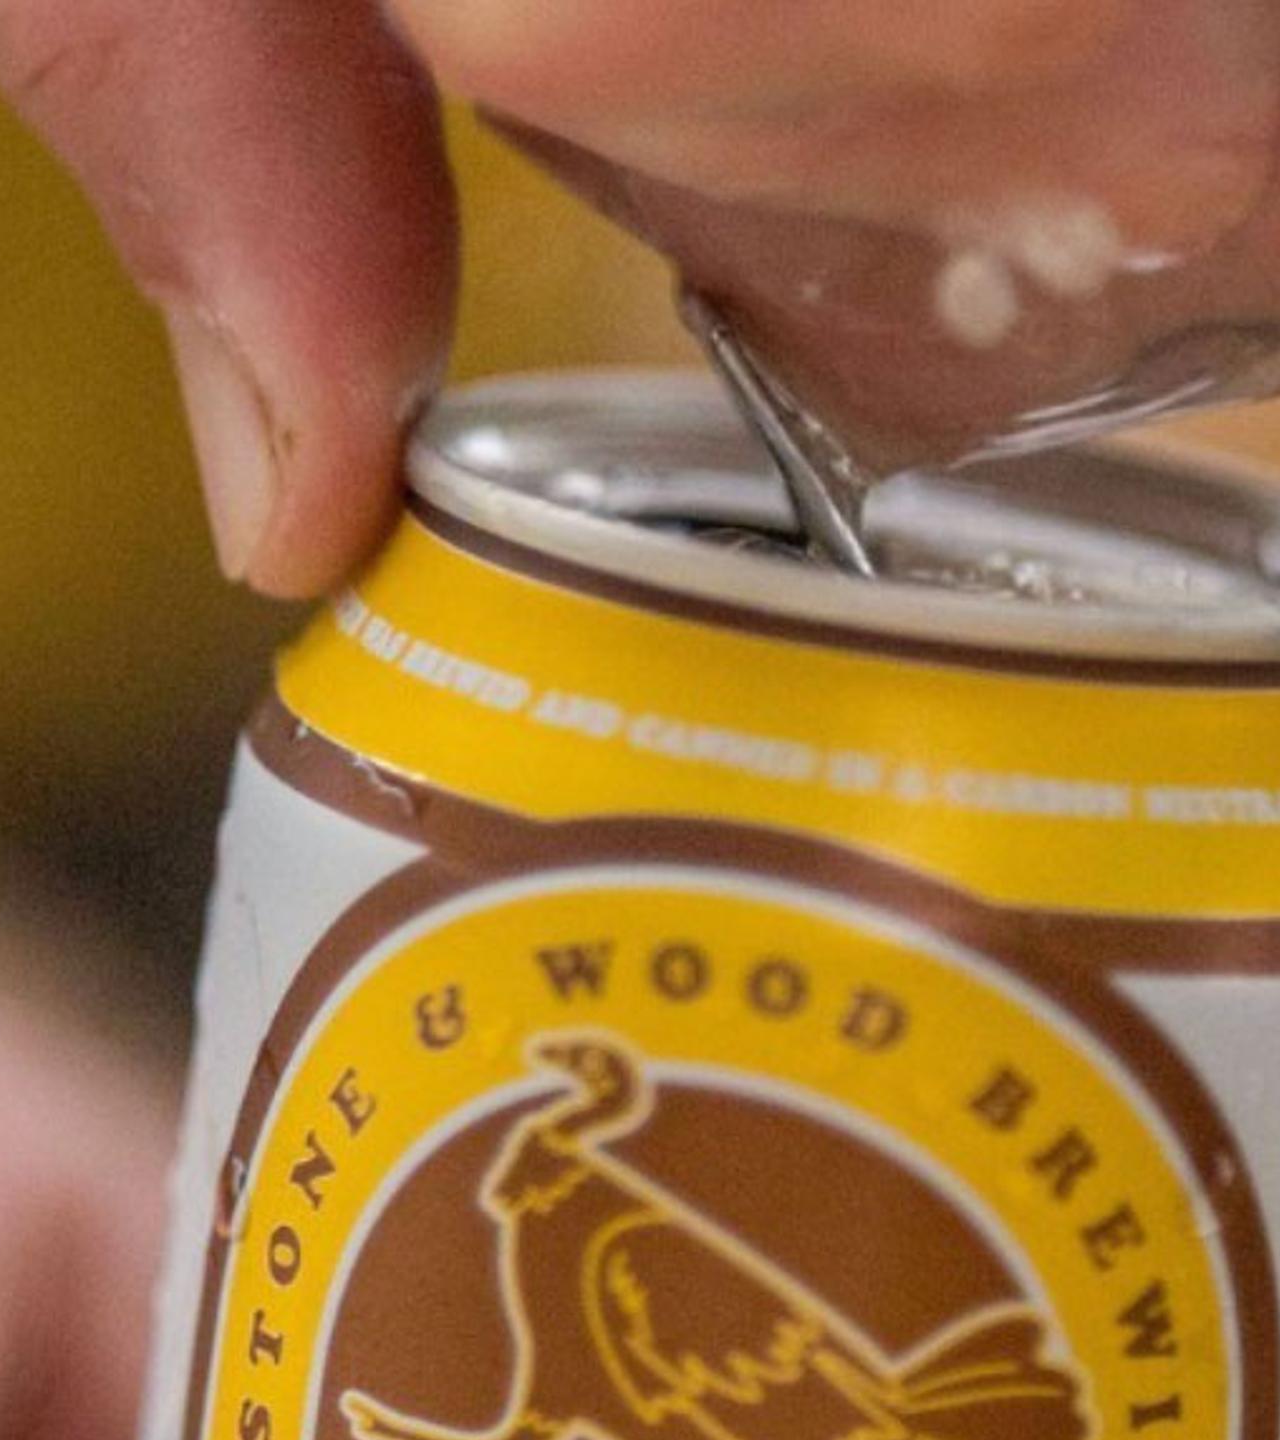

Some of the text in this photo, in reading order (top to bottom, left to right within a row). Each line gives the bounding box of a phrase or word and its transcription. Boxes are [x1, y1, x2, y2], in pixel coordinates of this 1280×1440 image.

[528, 690, 623, 740] AND
[414, 983, 468, 1051] &
[535, 940, 908, 1053] WOOD
